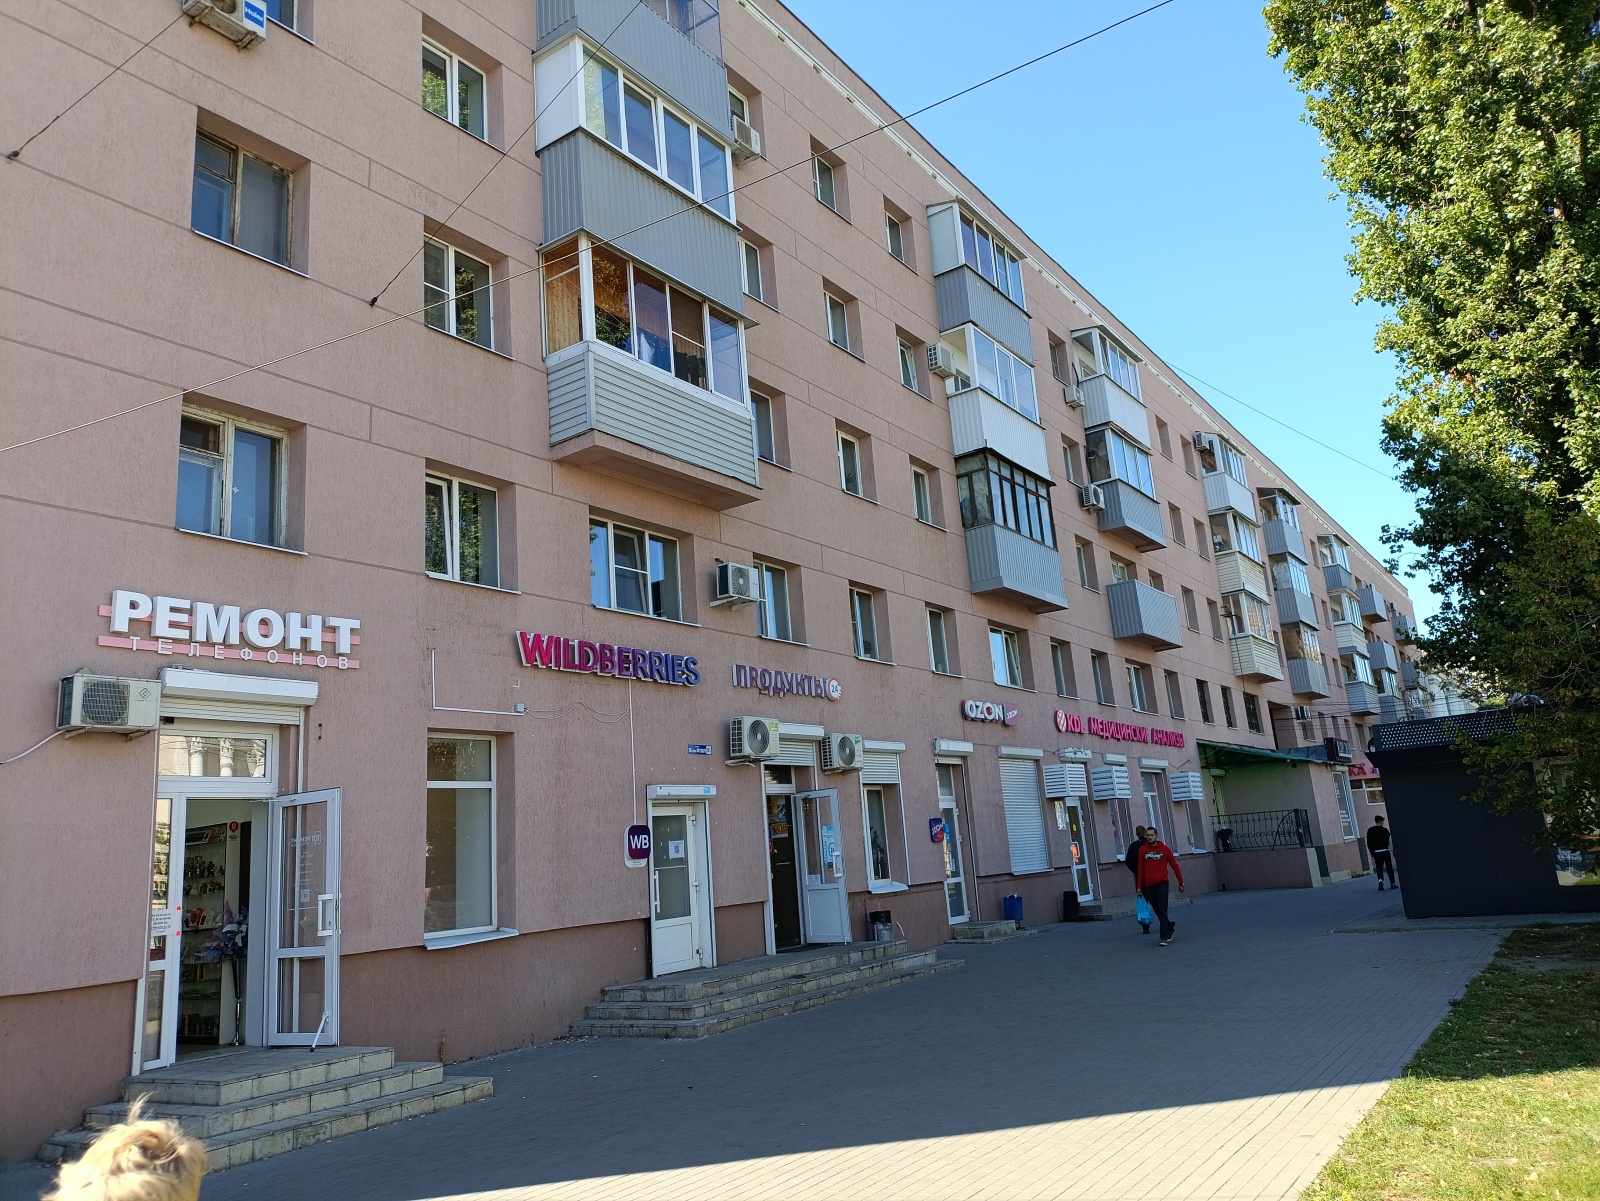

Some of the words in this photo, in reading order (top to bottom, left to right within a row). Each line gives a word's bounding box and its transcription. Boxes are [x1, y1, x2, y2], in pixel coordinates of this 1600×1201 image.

[245, 7, 264, 22] Haier
[110, 589, 361, 654] РЕМОНТ
[129, 636, 350, 670] ТЕЛЕФОНОВ
[515, 630, 701, 687] WILDBERRIES
[732, 663, 829, 698] ПРОДУКТЫ
[831, 684, 839, 693] 24
[963, 698, 1004, 722] OZON
[1065, 713, 1086, 734] KDL
[1088, 717, 1150, 743] МЕДИЦИНСКИЕ
[1151, 728, 1185, 748] АНАЛИЗЫ
[629, 834, 650, 850] WB
